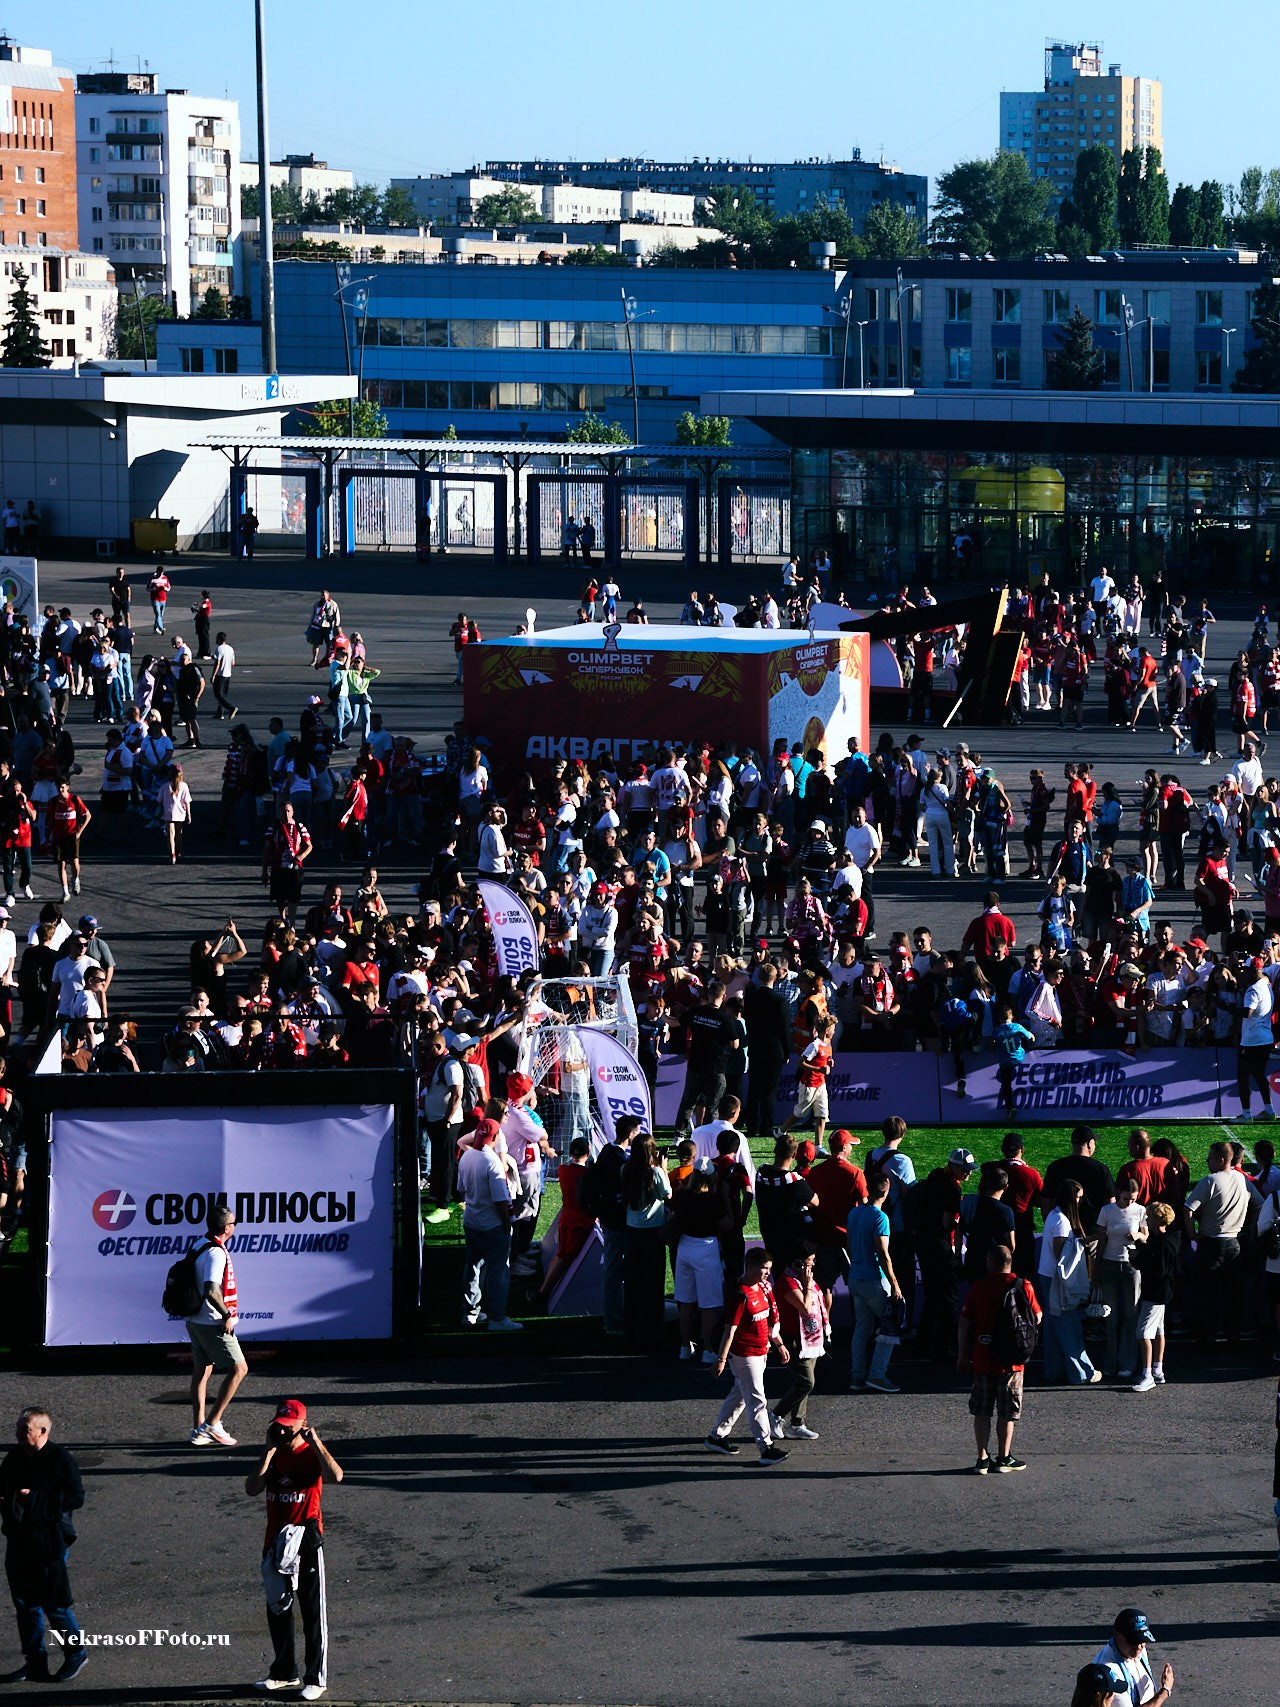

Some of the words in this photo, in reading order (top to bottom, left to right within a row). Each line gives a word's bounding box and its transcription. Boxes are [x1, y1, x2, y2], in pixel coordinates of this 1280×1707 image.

[270, 380, 278, 397] 2
[567, 652, 654, 665] OLIMPBET
[796, 645, 829, 660] OLIMPBET
[578, 665, 644, 675] СУПЕРКУБОК
[1002, 1037, 1017, 1052] 11
[612, 1066, 629, 1074] СВОИ
[830, 1087, 881, 1101] УТБОЛЕ
[235, 1191, 356, 1224] ПЛЮСЫ
[98, 1235, 202, 1256] ФЕСТИВАЛ
[225, 1232, 350, 1255] ОЛЕЛЬЩИКОВ
